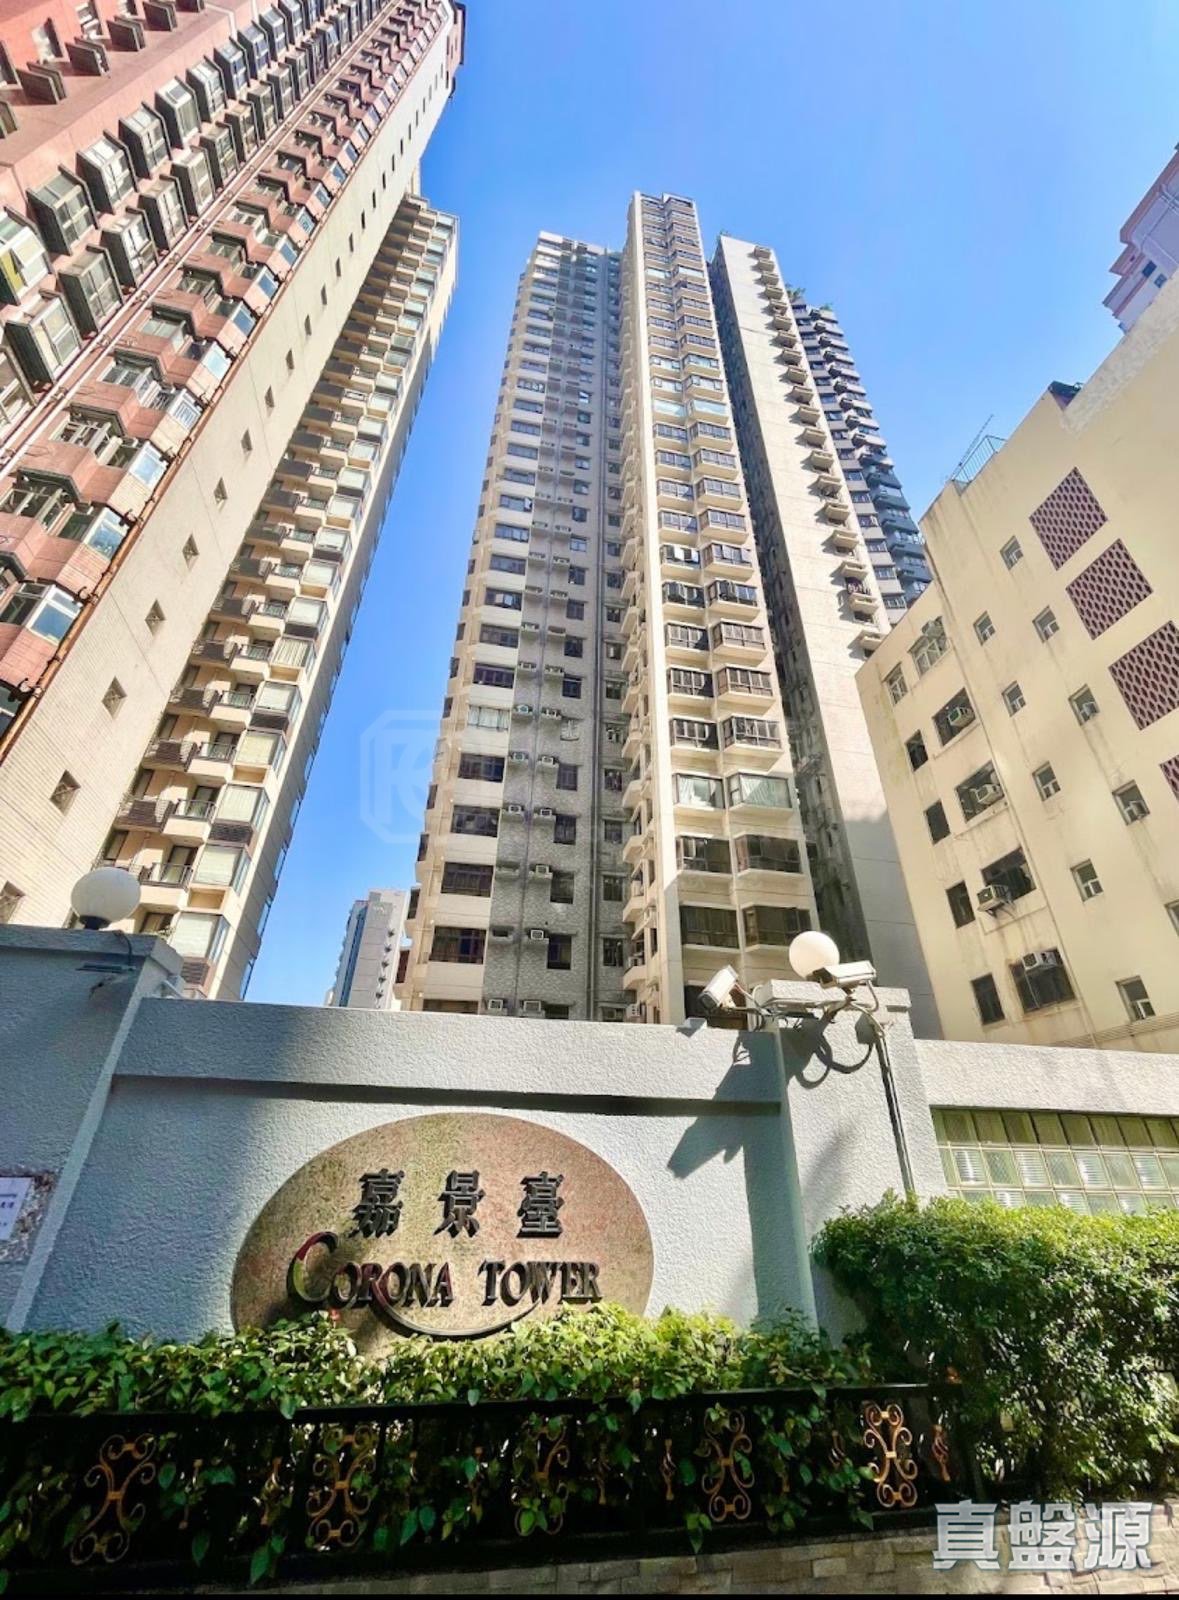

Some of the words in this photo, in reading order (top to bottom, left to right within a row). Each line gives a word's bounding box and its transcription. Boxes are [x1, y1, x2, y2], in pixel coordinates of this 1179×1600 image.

[348, 1168, 566, 1239] 嘉景臺
[286, 1231, 454, 1310] CORONA
[477, 1258, 602, 1307] TOWER
